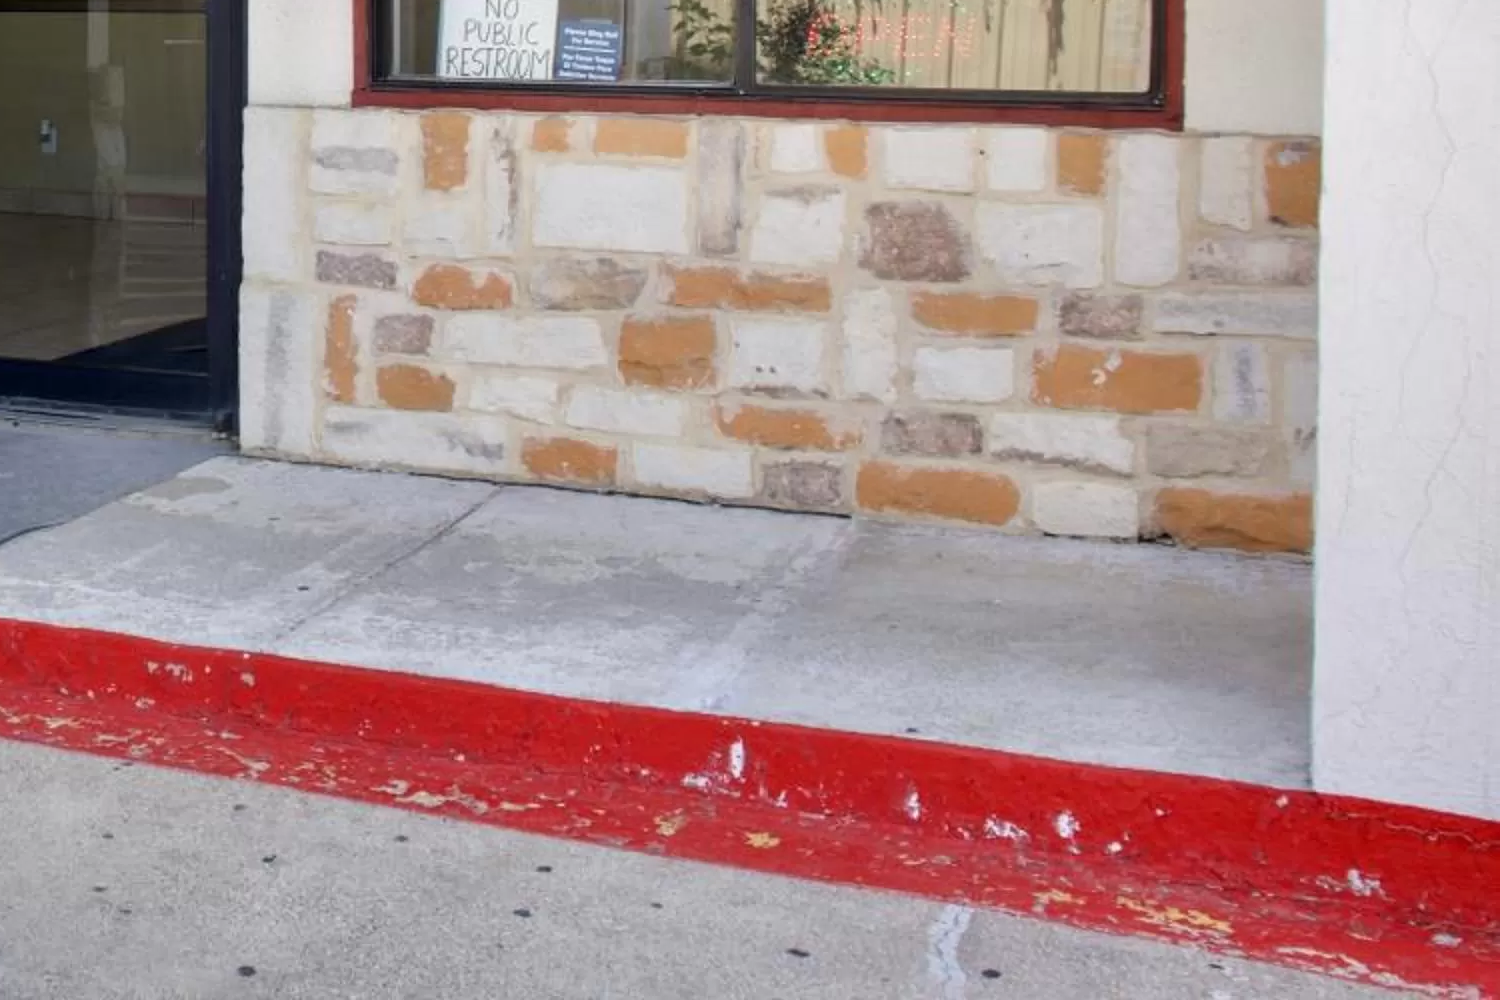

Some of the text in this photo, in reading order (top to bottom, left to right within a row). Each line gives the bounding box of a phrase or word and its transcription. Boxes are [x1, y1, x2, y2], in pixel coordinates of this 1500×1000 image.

[463, 18, 540, 47] PUBLIC
[805, 11, 976, 58] OPEN
[445, 46, 551, 80] RESTROOM
